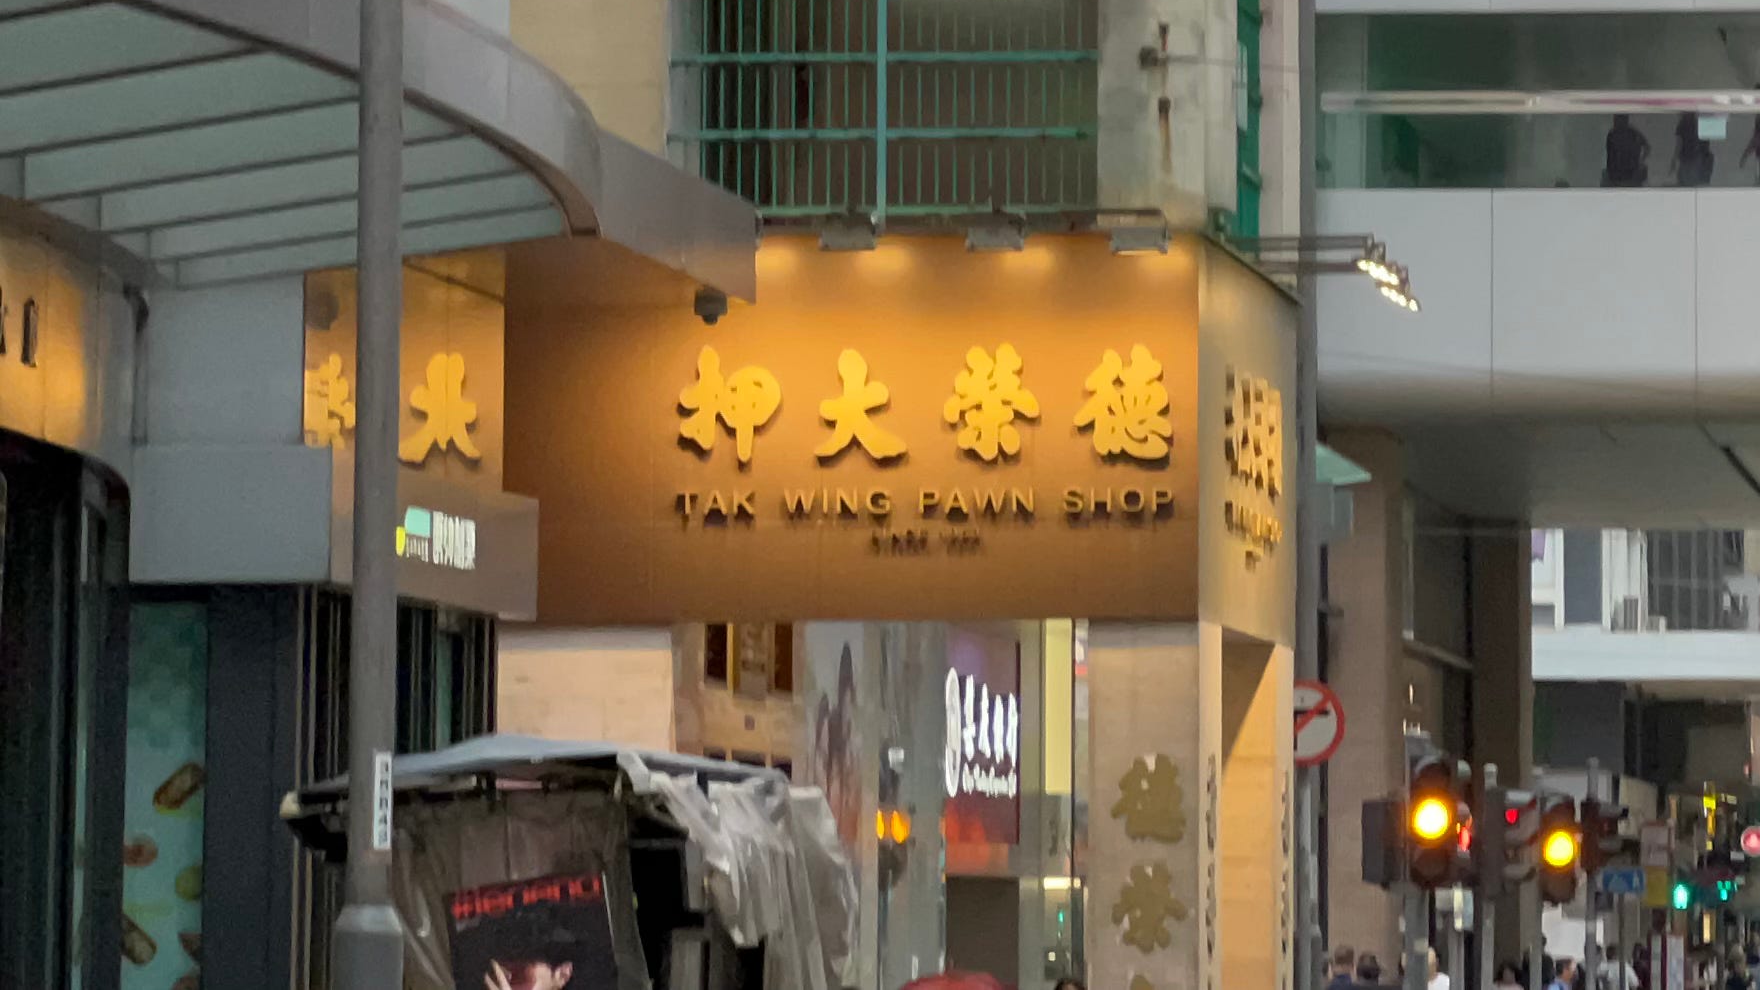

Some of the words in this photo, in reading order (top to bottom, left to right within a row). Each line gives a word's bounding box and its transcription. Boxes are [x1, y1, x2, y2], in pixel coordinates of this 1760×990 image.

[680, 489, 756, 515] TAK
[784, 488, 890, 515] WING
[918, 488, 1034, 514] PAWN
[1063, 487, 1174, 514] SHOP
